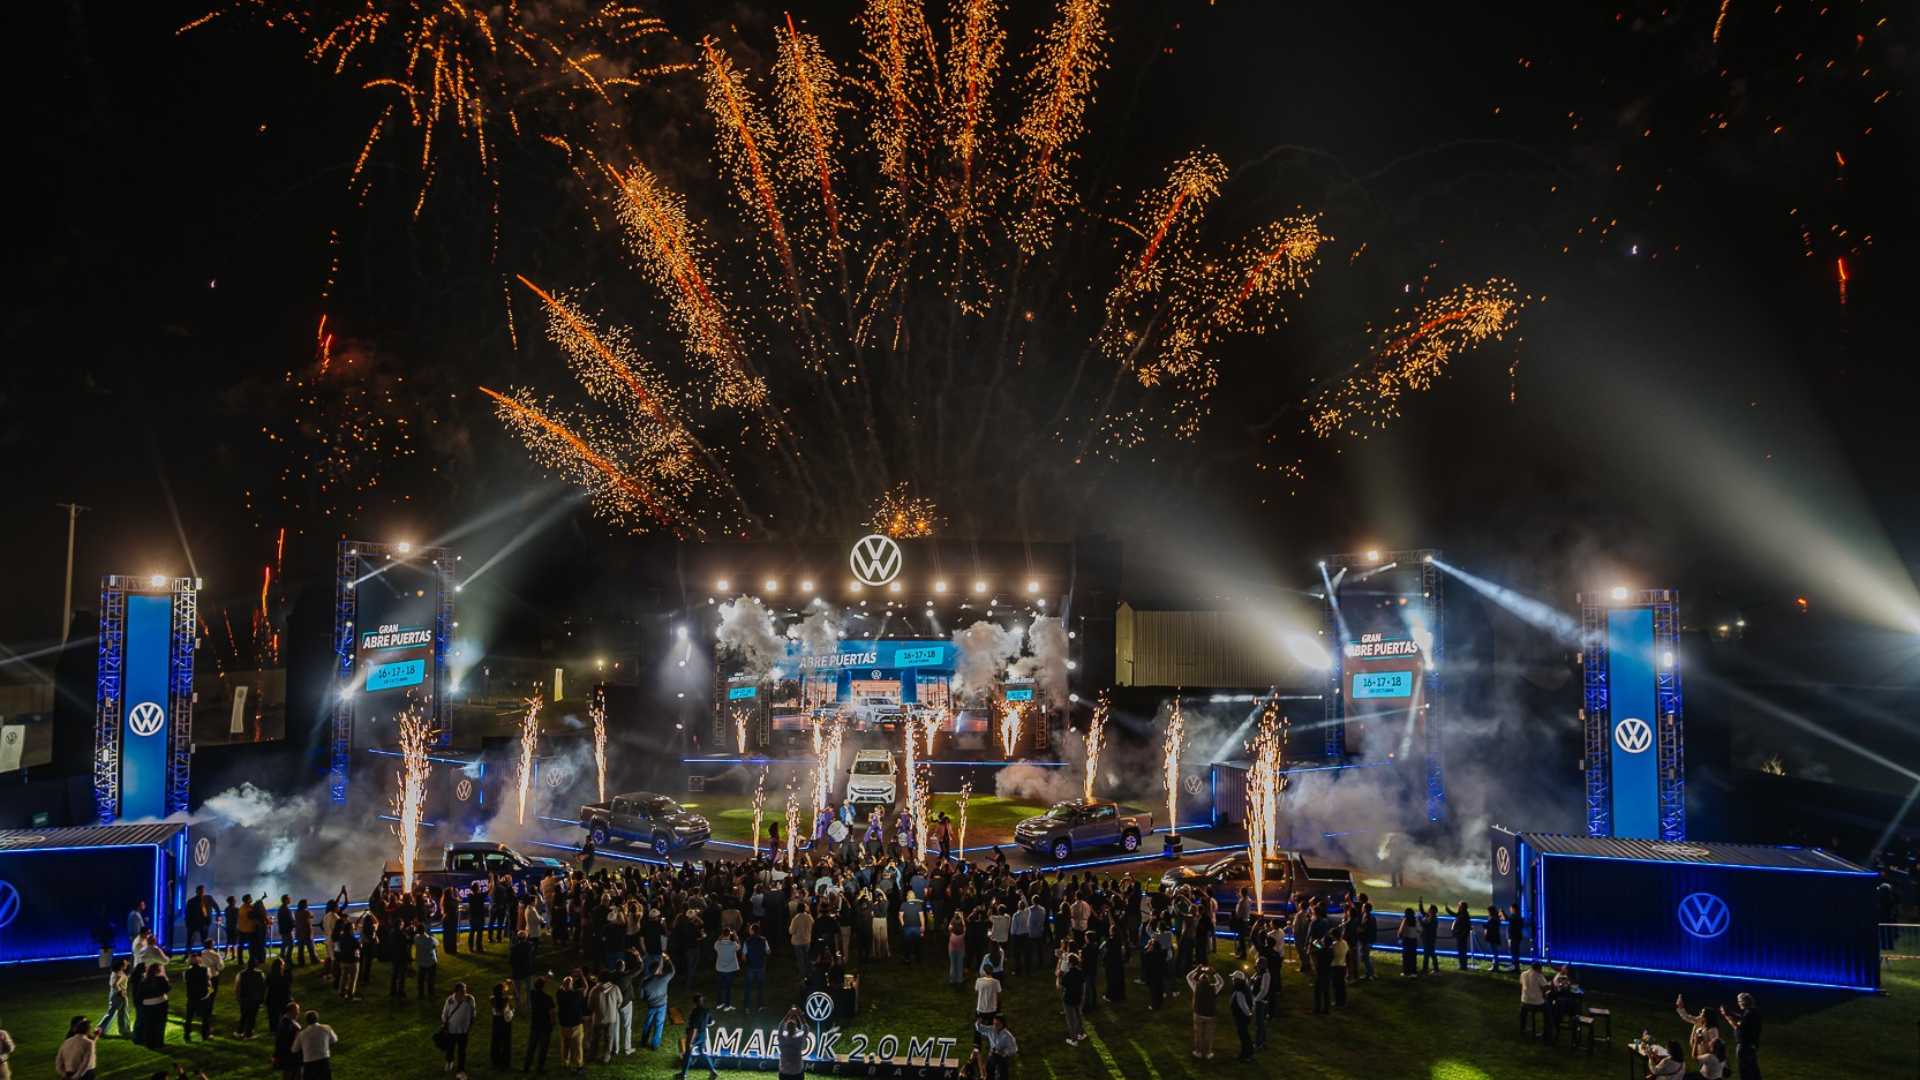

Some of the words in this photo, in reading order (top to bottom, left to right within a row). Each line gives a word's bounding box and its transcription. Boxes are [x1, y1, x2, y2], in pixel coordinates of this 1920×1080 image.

[378, 624, 399, 634] GRAN
[362, 635, 390, 649] ABRE
[390, 629, 432, 646] PUERTAS
[1361, 632, 1382, 643] GRAN
[1374, 640, 1418, 656] PUERTAS
[800, 655, 828, 669] ABRE
[828, 652, 878, 666] PUERTAS
[848, 1033, 899, 1061] 2.0
[906, 1036, 957, 1066] MT
